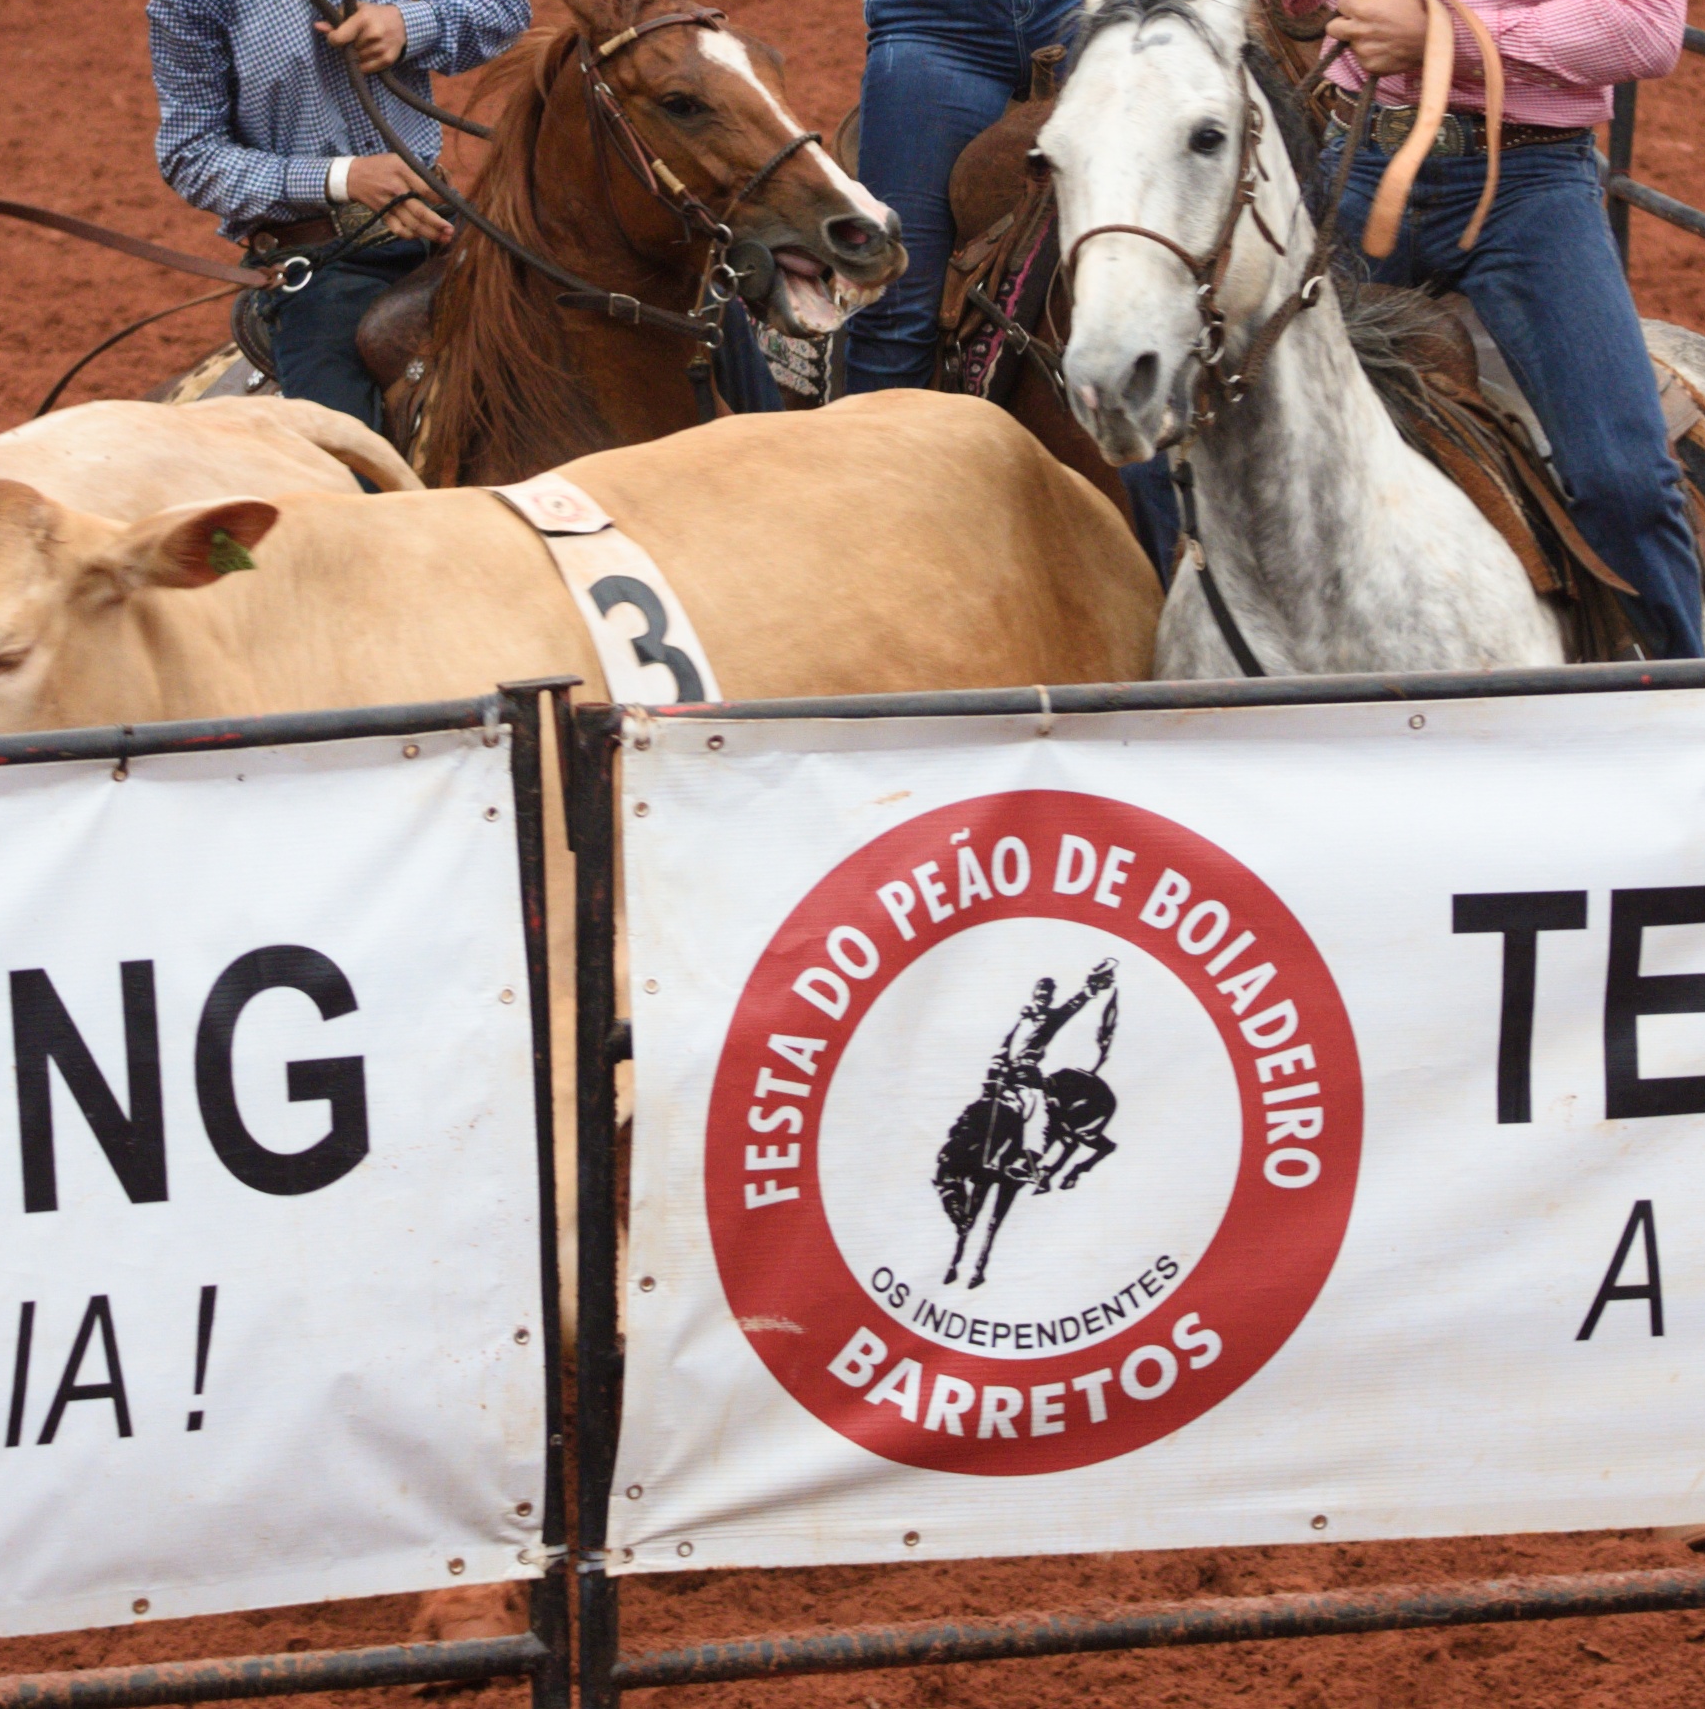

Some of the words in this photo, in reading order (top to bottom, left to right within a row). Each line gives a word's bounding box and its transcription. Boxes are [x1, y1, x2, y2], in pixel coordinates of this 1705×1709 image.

[588, 575, 705, 702] 3
[744, 1030, 828, 1210] FESTA
[792, 923, 881, 1021] DO
[875, 828, 1031, 941] PEÃO
[1052, 834, 1137, 909] DE
[1138, 868, 1325, 1189] BOIADEIRO
[869, 1264, 911, 1309] OS
[911, 1252, 1182, 1351] INDEPENDENTES
[1574, 1198, 1665, 1341] A
[826, 1311, 1225, 1440] BARRETOS
